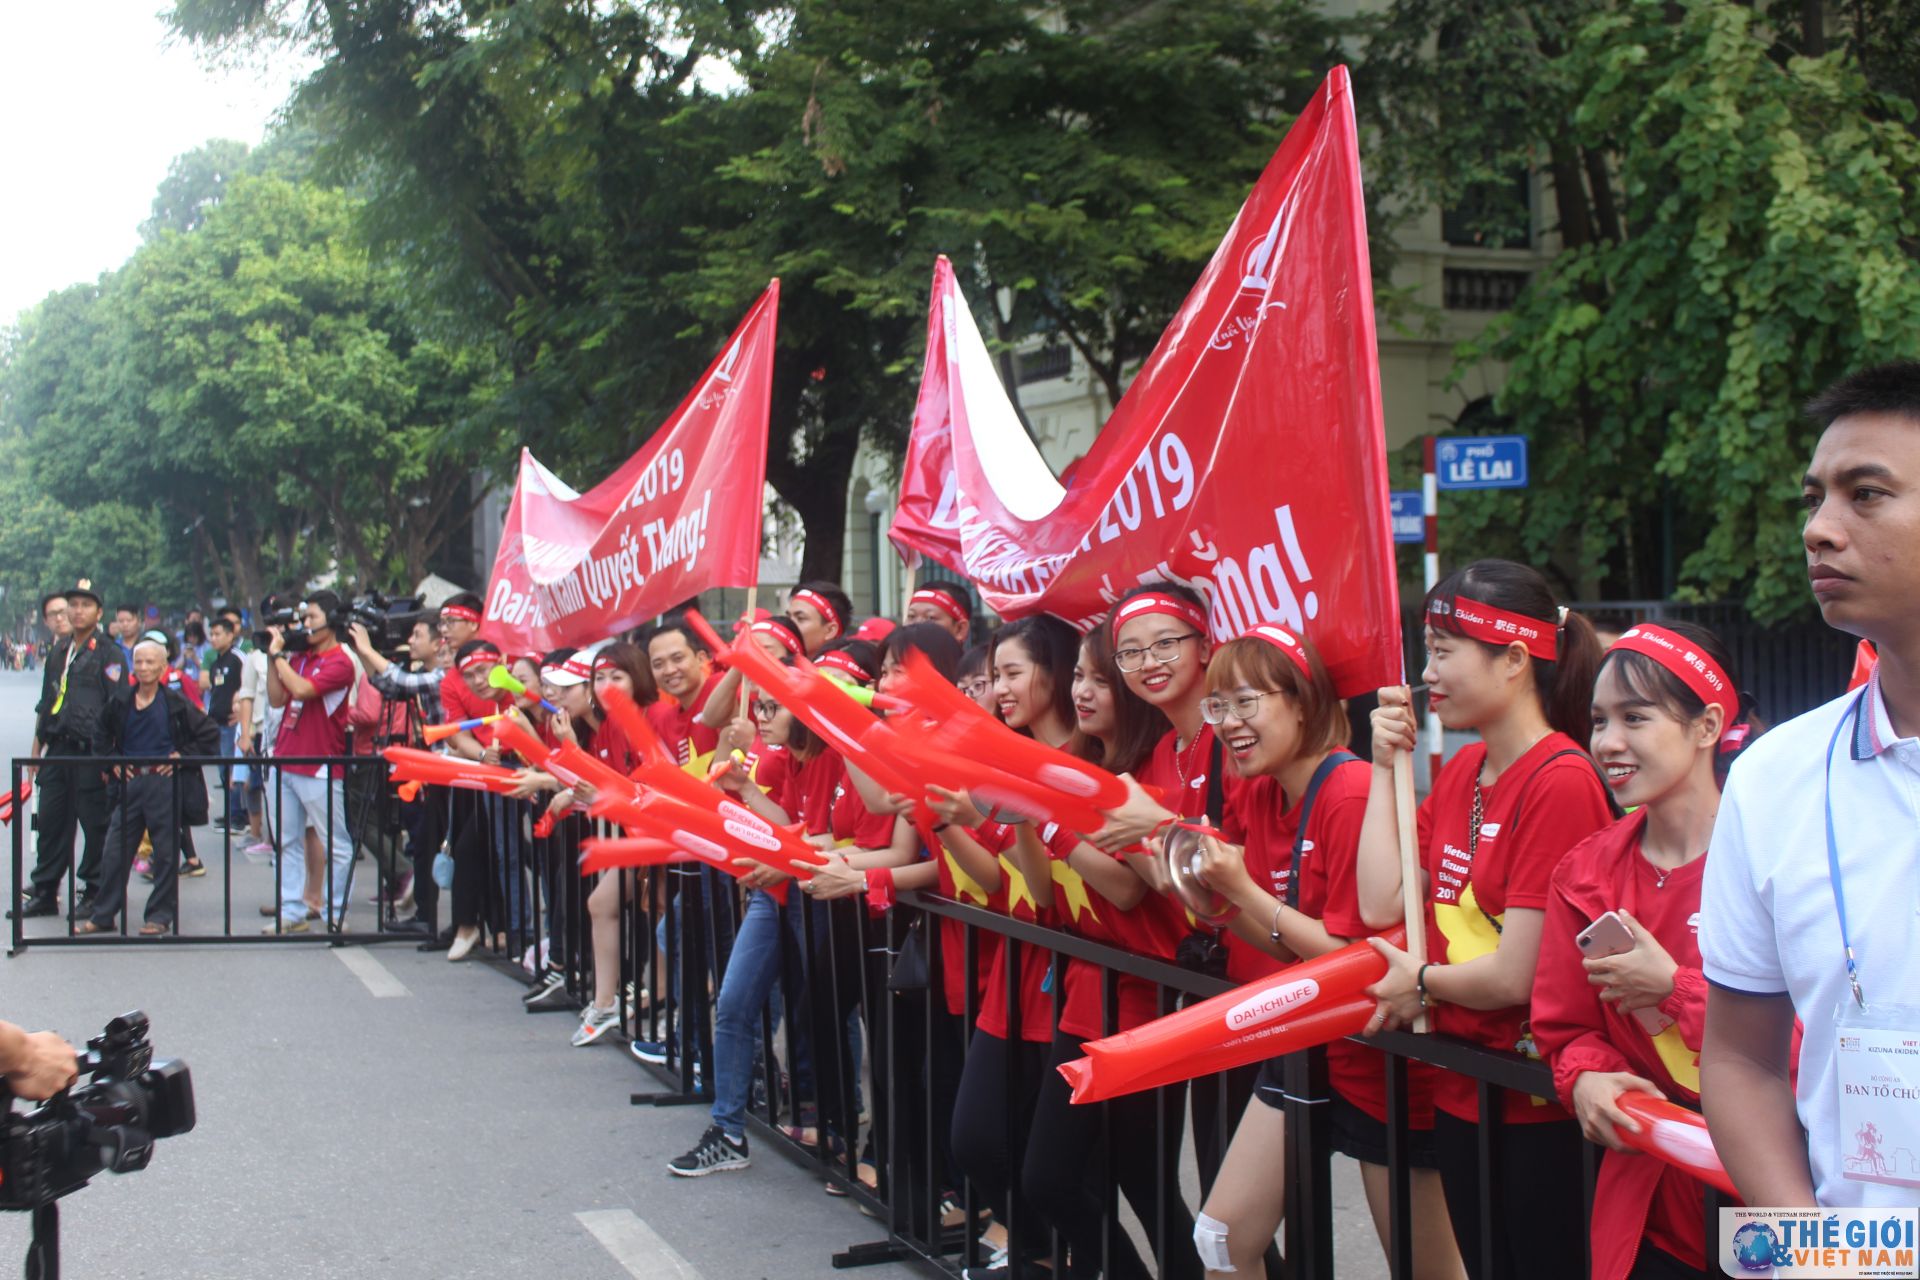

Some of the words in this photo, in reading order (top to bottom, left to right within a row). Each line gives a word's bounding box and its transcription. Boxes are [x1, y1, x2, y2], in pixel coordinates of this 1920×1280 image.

[1466, 442, 1495, 458] PHỐ
[631, 448, 685, 509] 2019
[1449, 457, 1476, 482] LÊ
[1479, 459, 1513, 481] LAI
[580, 524, 646, 612] Quyết
[1455, 608, 1484, 625] Ekiden
[1494, 619, 1517, 634] 駅伝
[1518, 626, 1538, 639] 2019
[1641, 631, 1674, 650] Ekiden
[1683, 651, 1707, 673] 駅伝
[1705, 670, 1723, 691] 2019
[1443, 843, 1472, 861] Vietna
[1436, 886, 1456, 900] 201
[1233, 996, 1285, 1025] DAI-ICHI
[1285, 985, 1313, 1004] LIFE
[1868, 1046, 1893, 1054] KIZUNA
[1894, 1047, 1919, 1055] EKIDEN
[1845, 1084, 1869, 1097] BAN
